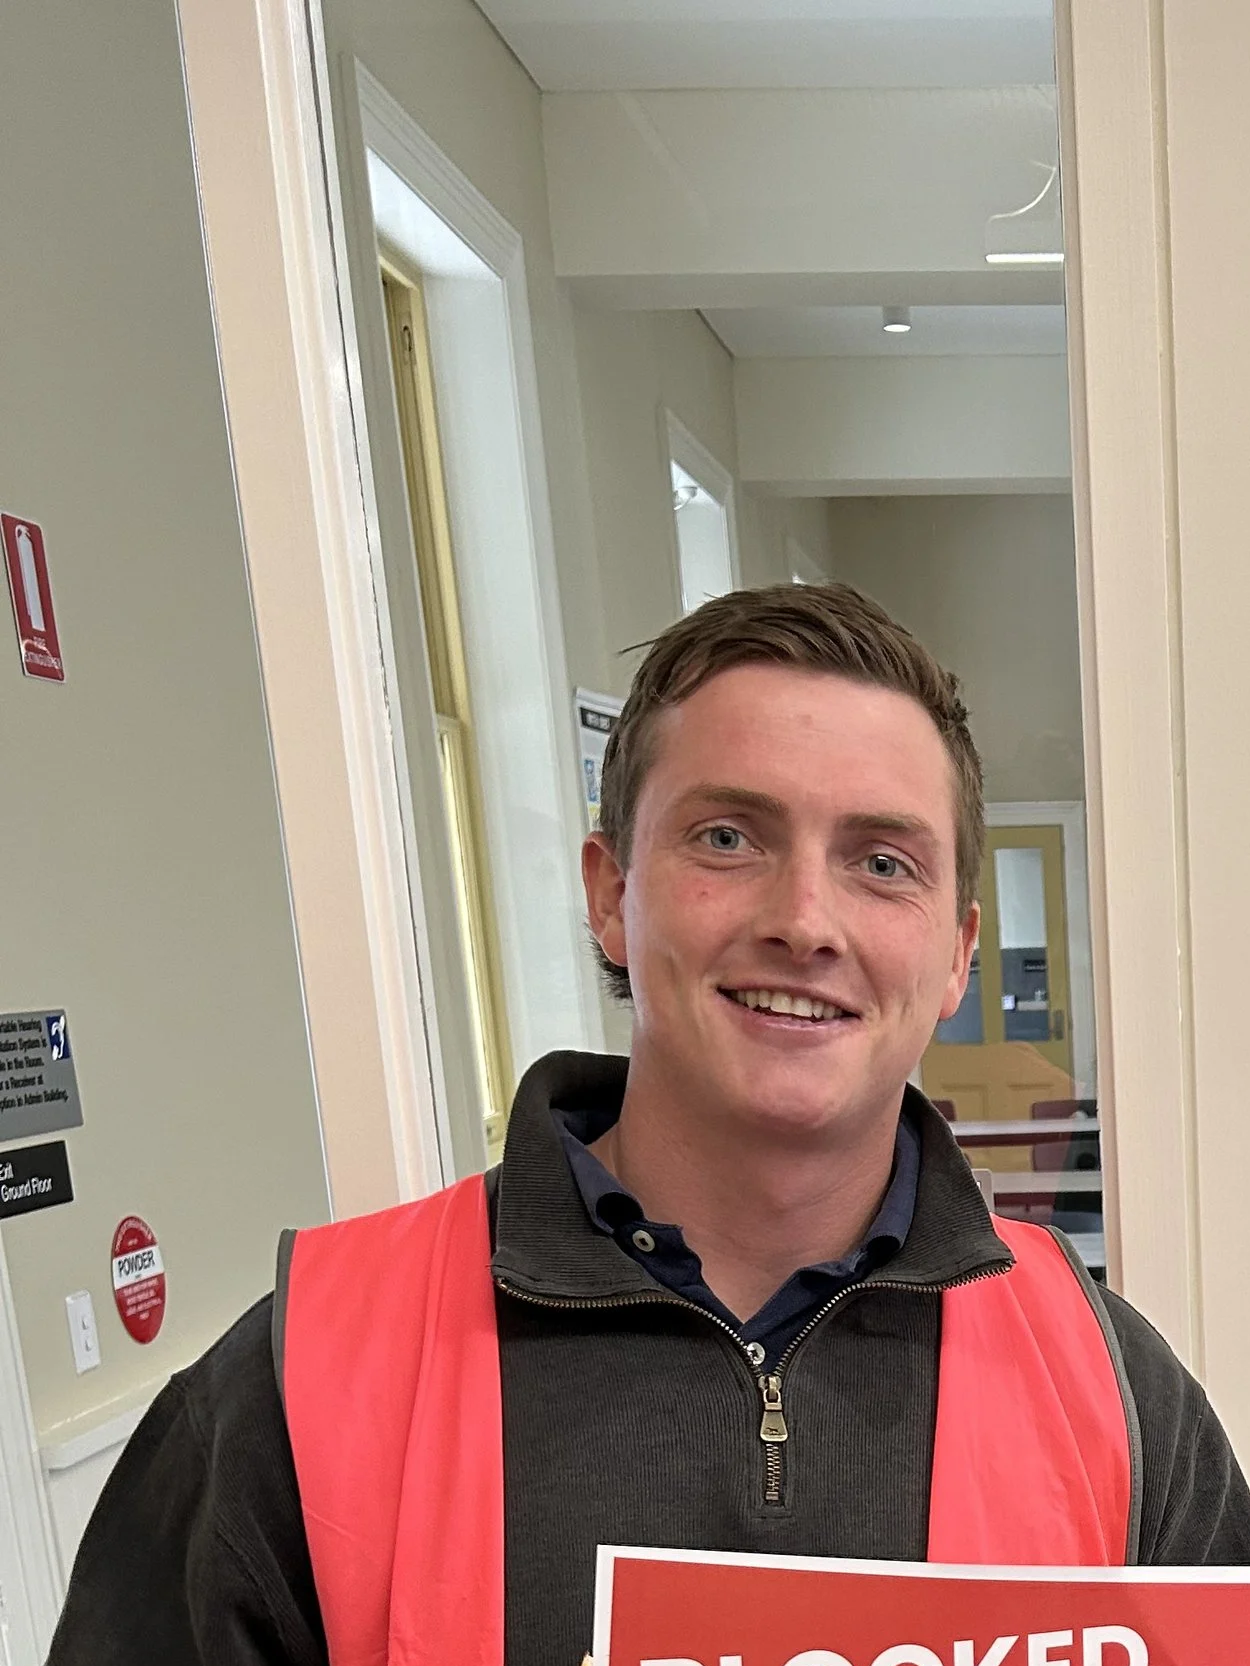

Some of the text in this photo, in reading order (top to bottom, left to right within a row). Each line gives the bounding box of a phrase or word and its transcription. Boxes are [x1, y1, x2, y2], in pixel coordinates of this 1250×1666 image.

[1, 1177, 52, 1202] Ground Floor
[118, 1250, 155, 1278] POWDER
